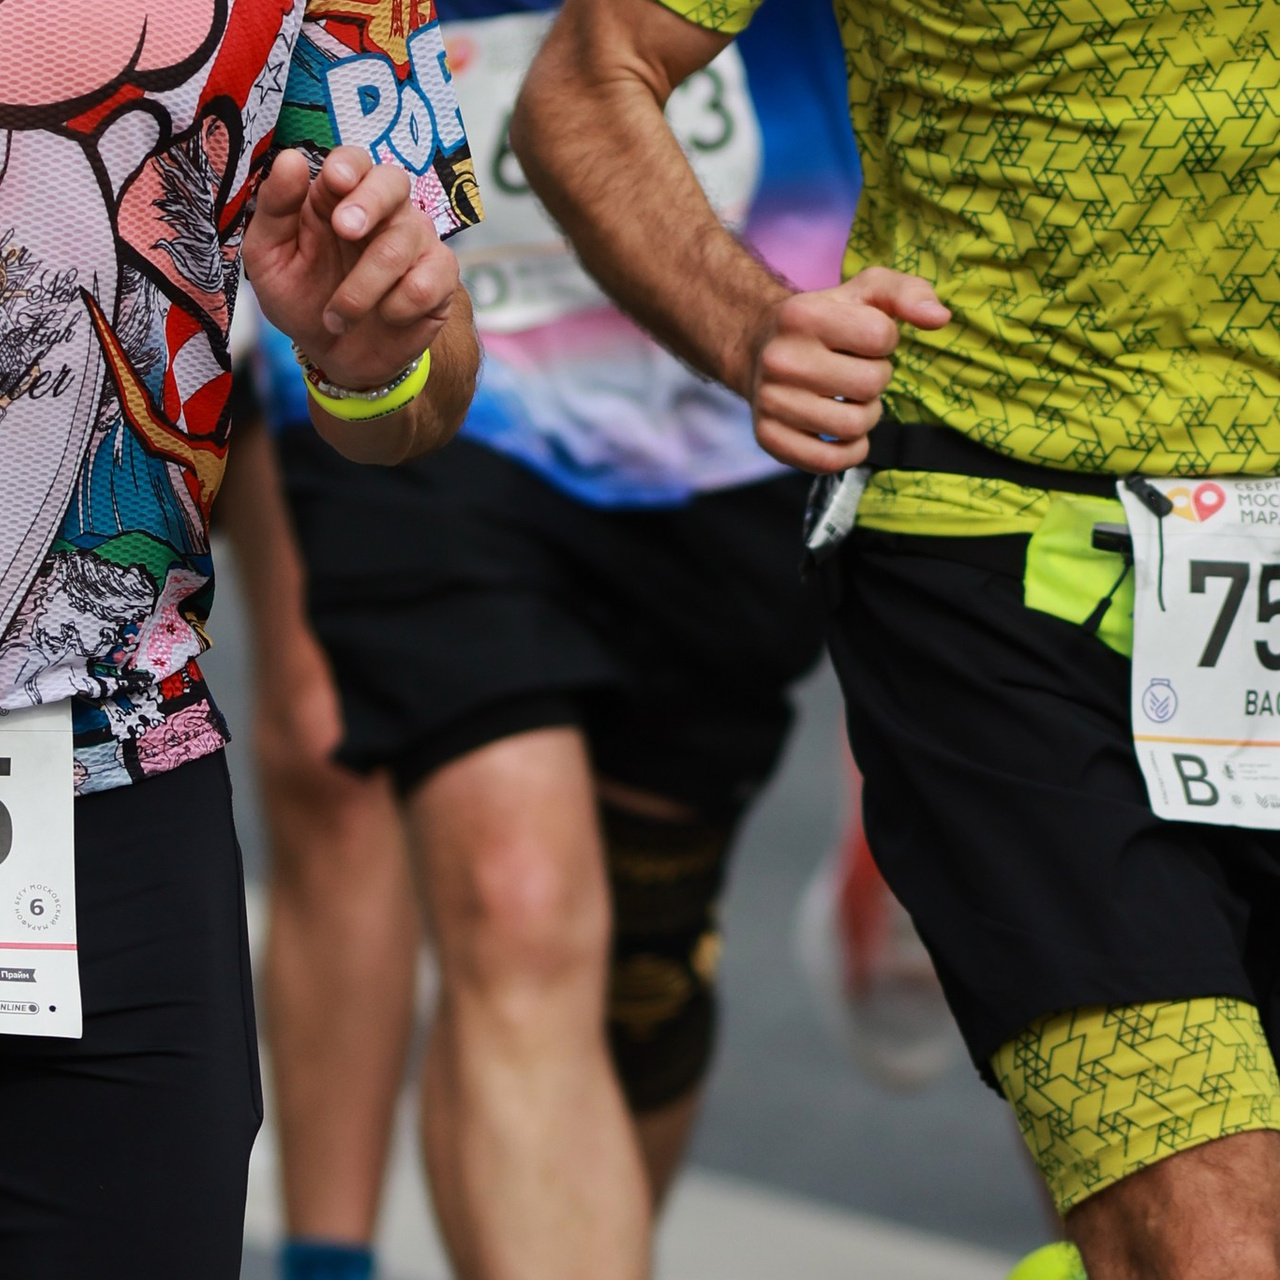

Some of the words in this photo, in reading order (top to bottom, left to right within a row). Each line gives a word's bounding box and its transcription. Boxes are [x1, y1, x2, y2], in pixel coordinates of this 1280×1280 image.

[26, 268, 82, 304] Nor
[1241, 510, 1280, 525] МАР
[1245, 689, 1280, 716] ВА
[30, 898, 44, 916] 6
[1, 970, 29, 979] Прайм
